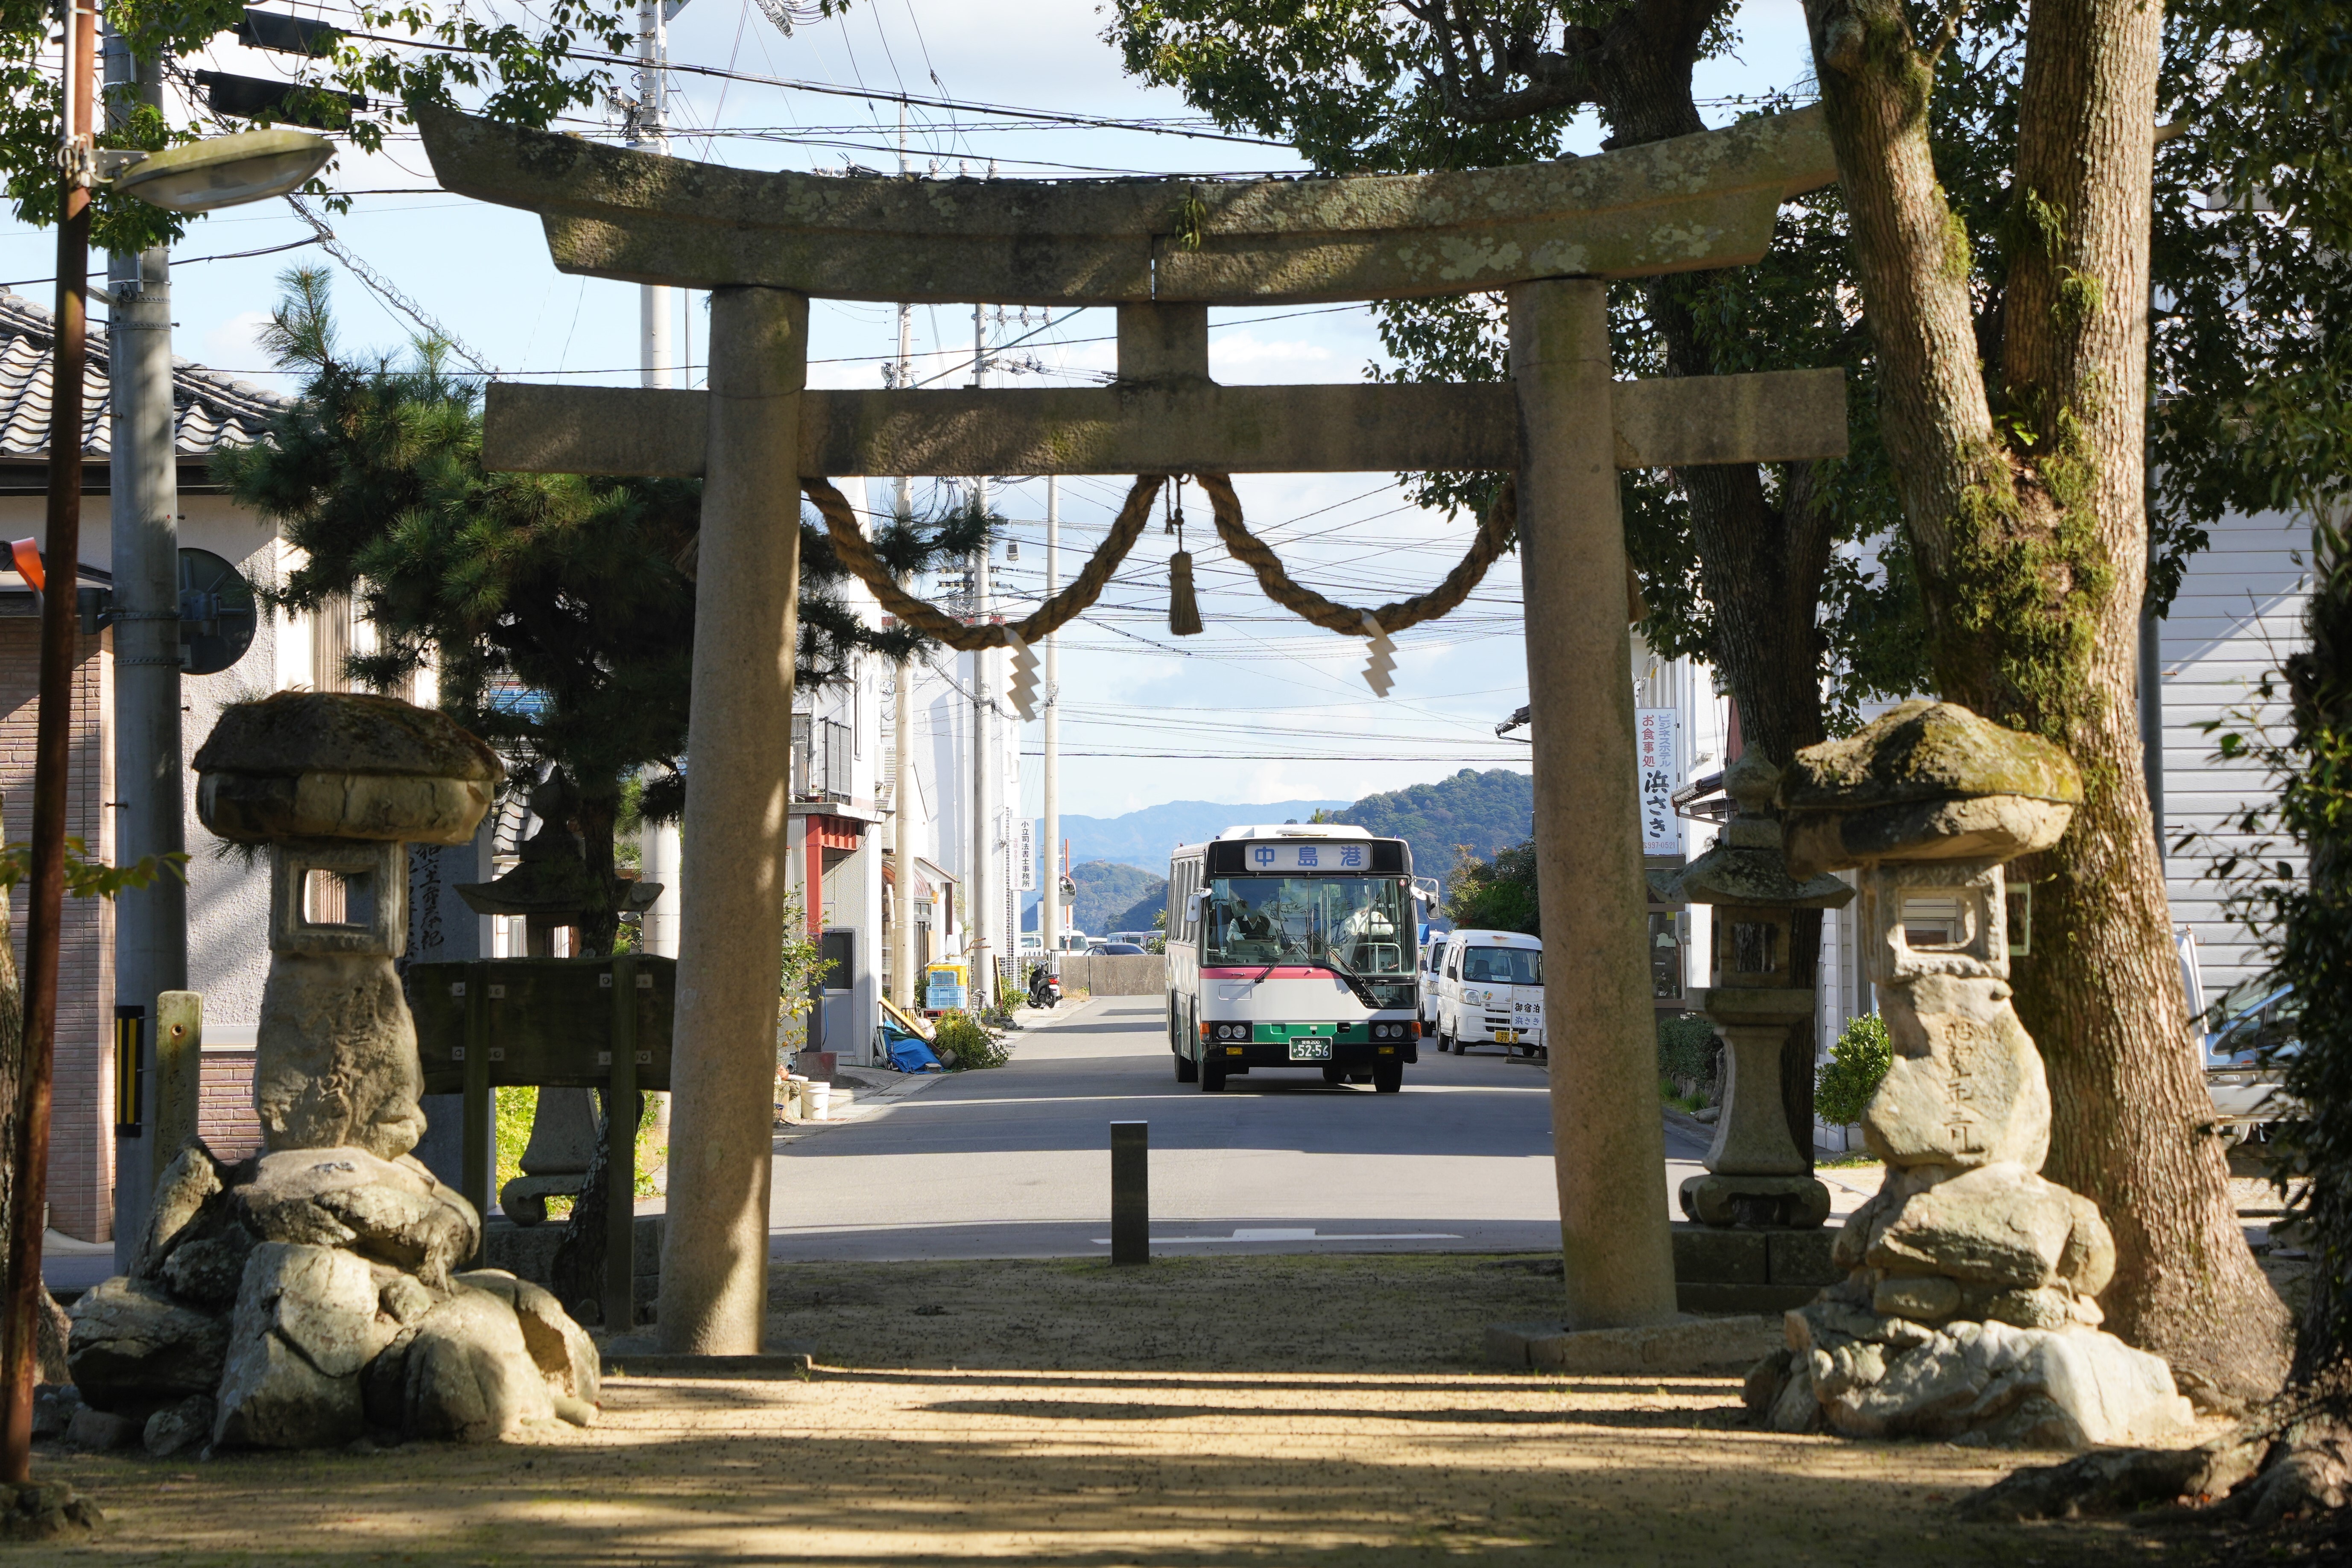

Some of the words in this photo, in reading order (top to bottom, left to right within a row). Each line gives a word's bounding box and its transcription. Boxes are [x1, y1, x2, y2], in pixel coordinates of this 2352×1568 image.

[1641, 714, 1655, 767] お食事処
[1659, 714, 1671, 767] ビジネスホテル
[1644, 770, 1669, 838] 浜さき
[1013, 838, 1018, 848] 電話
[1021, 821, 1030, 887] 小立司法書士事務所
[1255, 845, 1361, 867] 中島港
[1515, 1002, 1540, 1013] 御宿泊
[1515, 1016, 1540, 1025] 浜さき
[1298, 1044, 1329, 1057] 52-56
